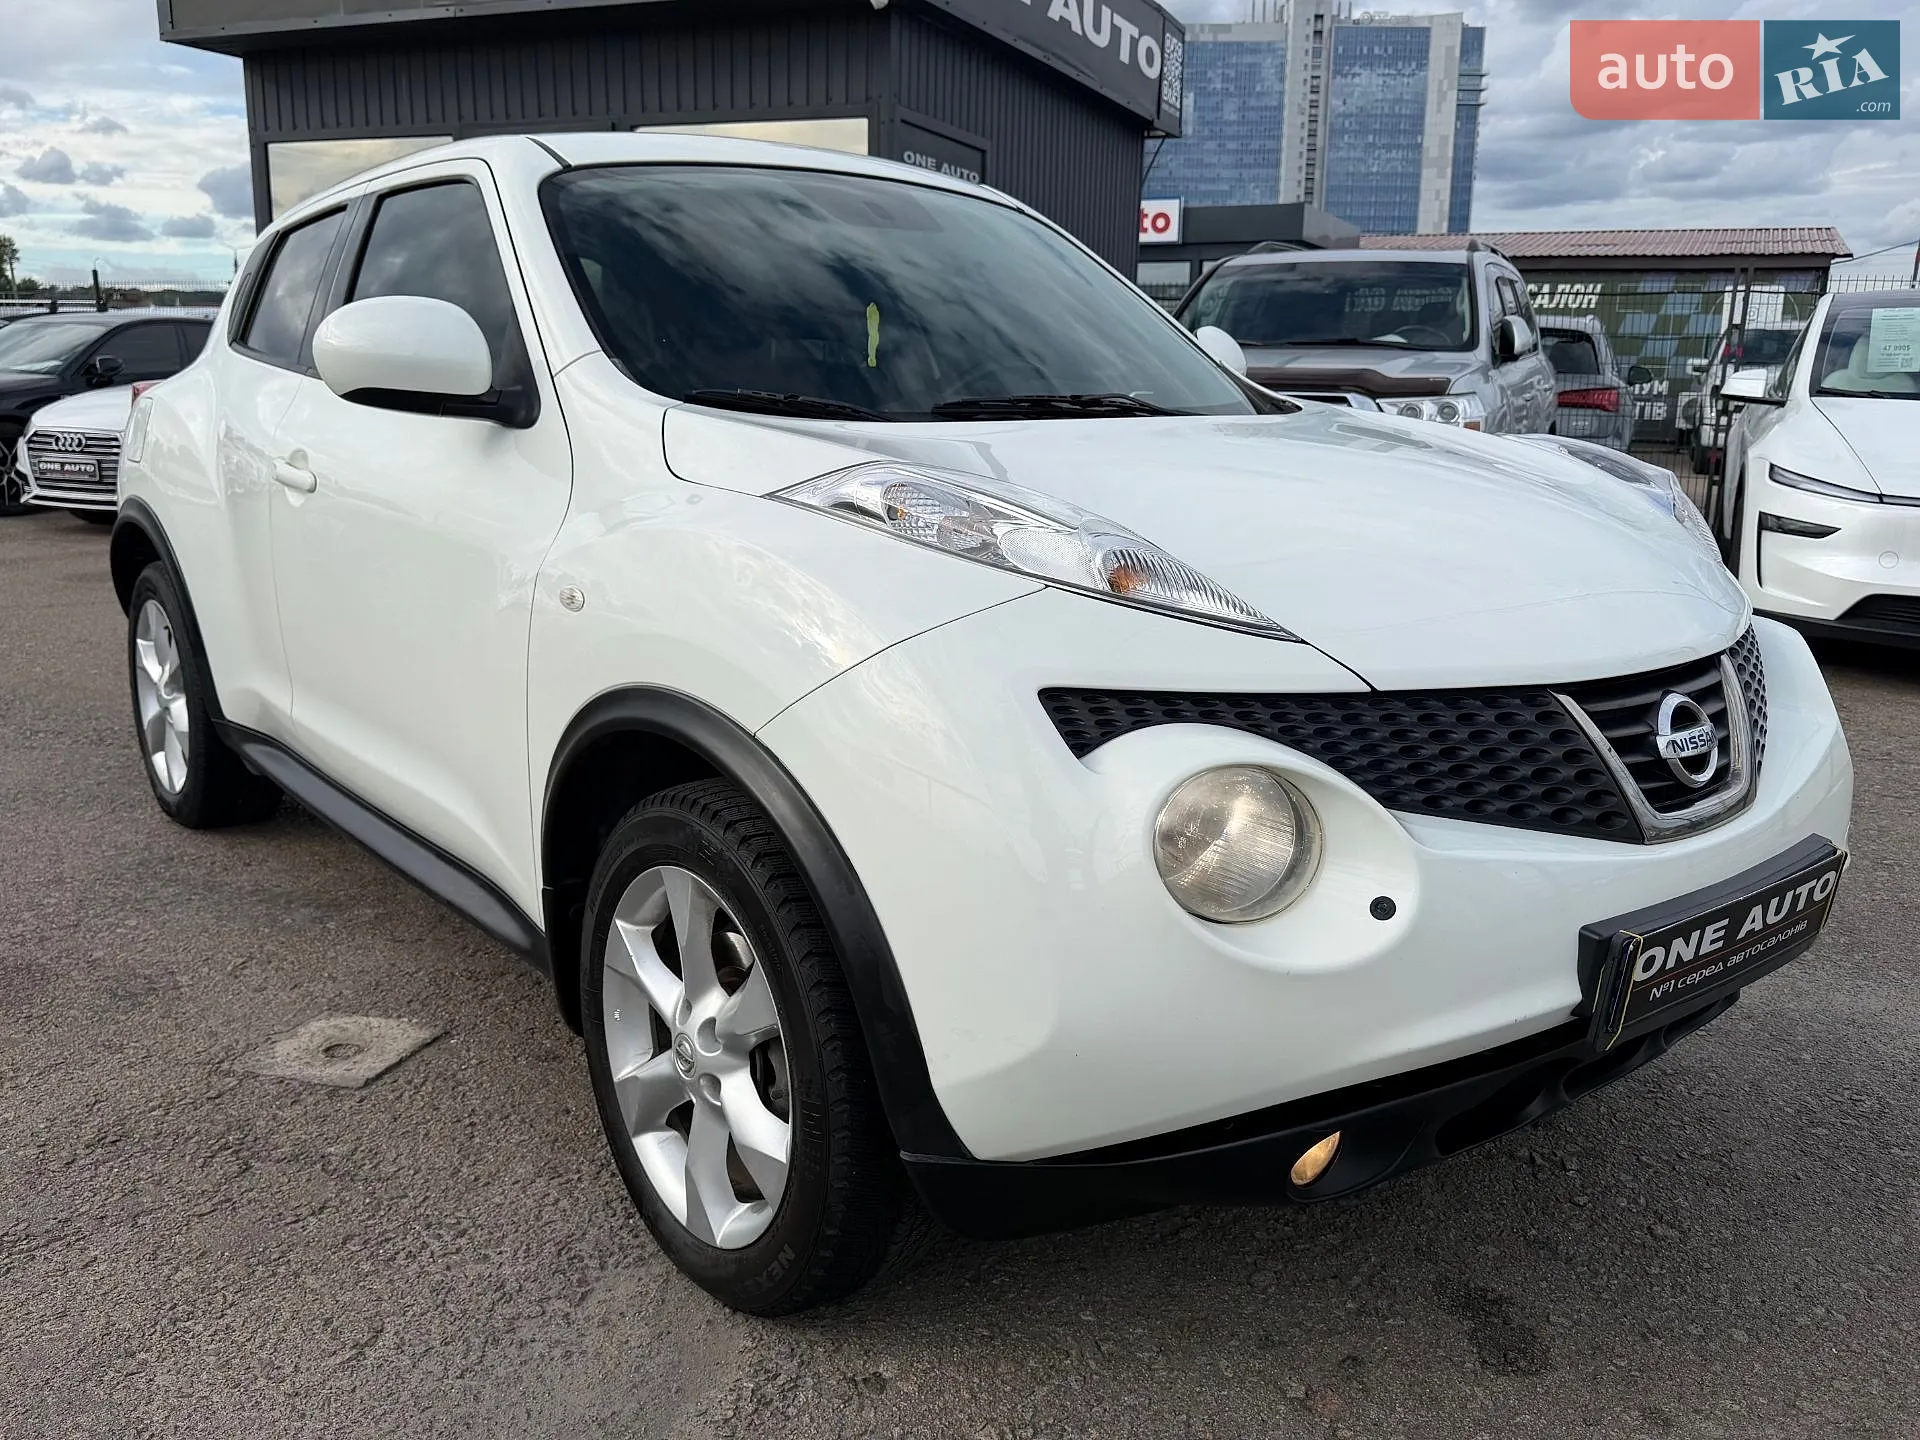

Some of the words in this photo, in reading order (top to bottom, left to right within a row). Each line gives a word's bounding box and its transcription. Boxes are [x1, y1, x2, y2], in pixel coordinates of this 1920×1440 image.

[1047, 0, 1162, 80] AUTO
[903, 151, 937, 171] ONE
[941, 162, 980, 184] AUTO
[39, 462, 61, 470] ONE
[64, 464, 95, 472] AUTO
[1633, 917, 1730, 983] ONE
[1736, 870, 1837, 941] AUTO
[1649, 980, 1676, 1002] №1
[1677, 961, 1725, 990] серед
[1726, 920, 1808, 968] автосалонів
